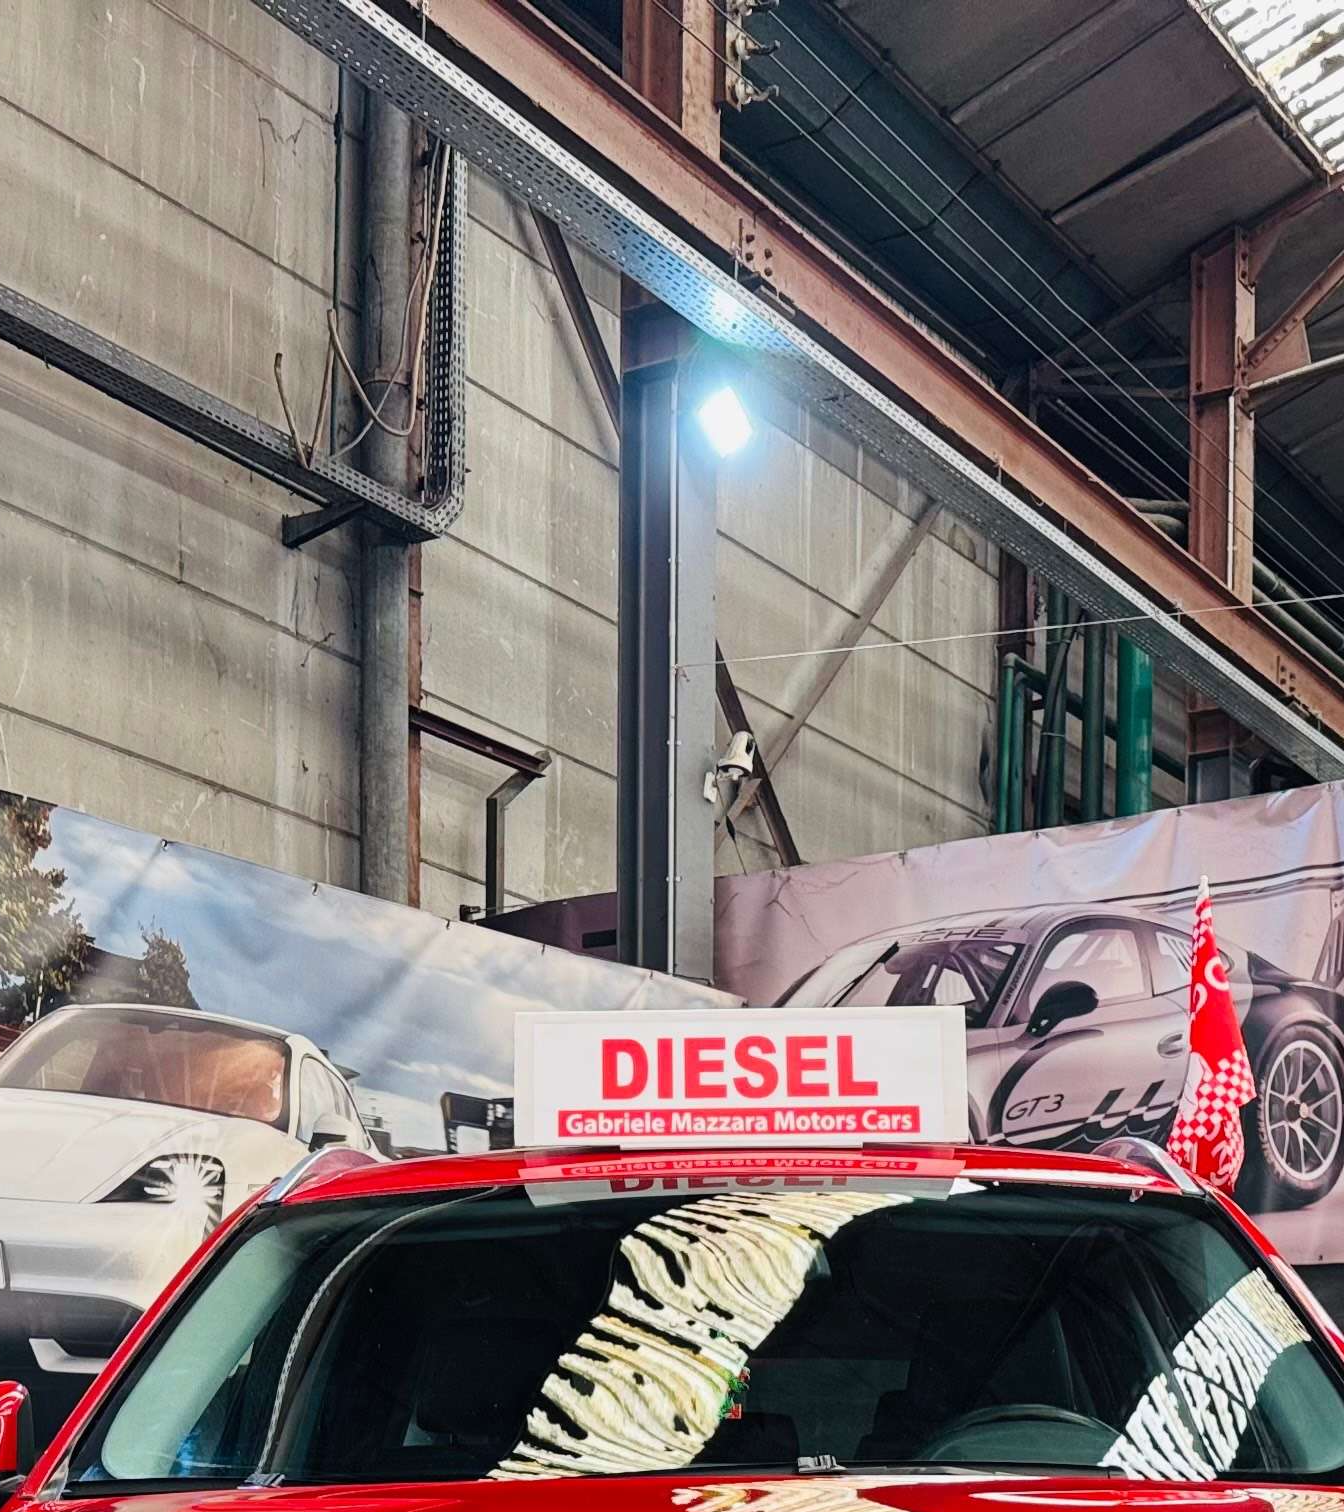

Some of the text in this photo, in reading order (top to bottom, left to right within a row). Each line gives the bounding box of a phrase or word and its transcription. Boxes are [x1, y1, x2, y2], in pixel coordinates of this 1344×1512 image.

[601, 1035, 879, 1100] DIESEL
[566, 1108, 912, 1136] Gabriele Mazzara Motors Cars
